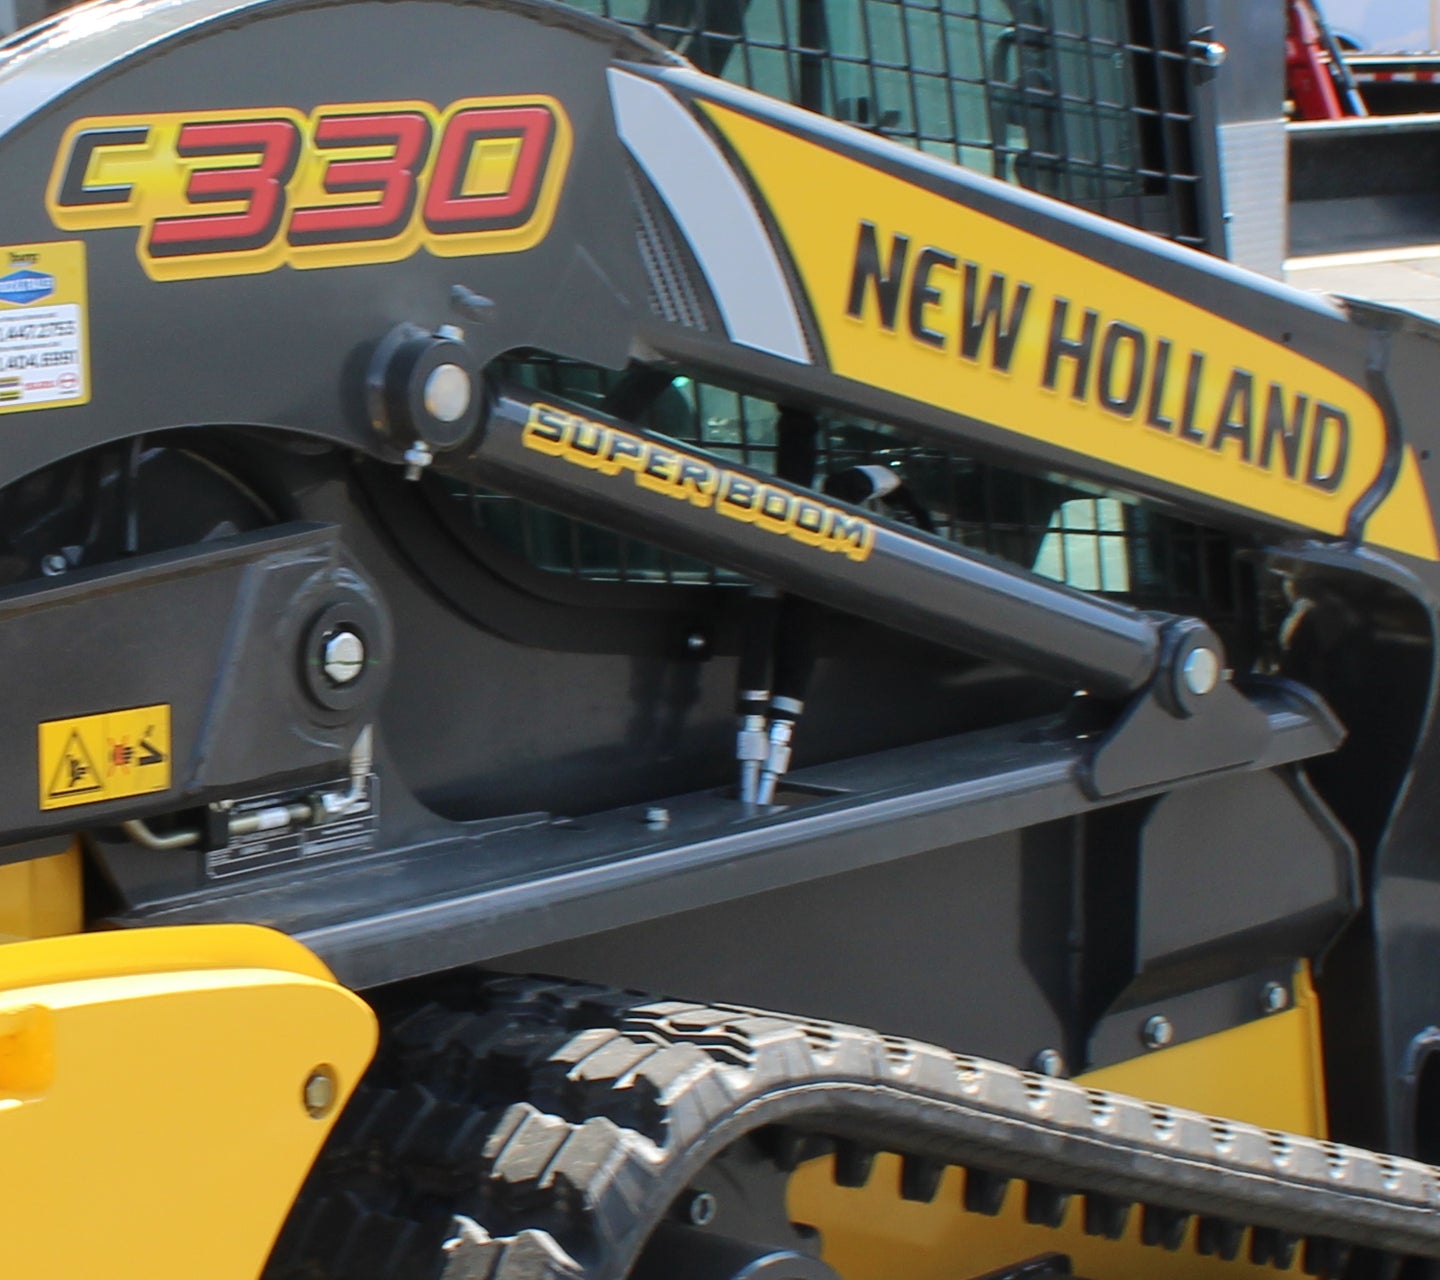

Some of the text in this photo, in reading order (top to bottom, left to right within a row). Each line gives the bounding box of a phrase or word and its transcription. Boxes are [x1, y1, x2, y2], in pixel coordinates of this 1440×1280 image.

[47, 95, 572, 280] C330
[846, 220, 1351, 495] NEW HOLLAND
